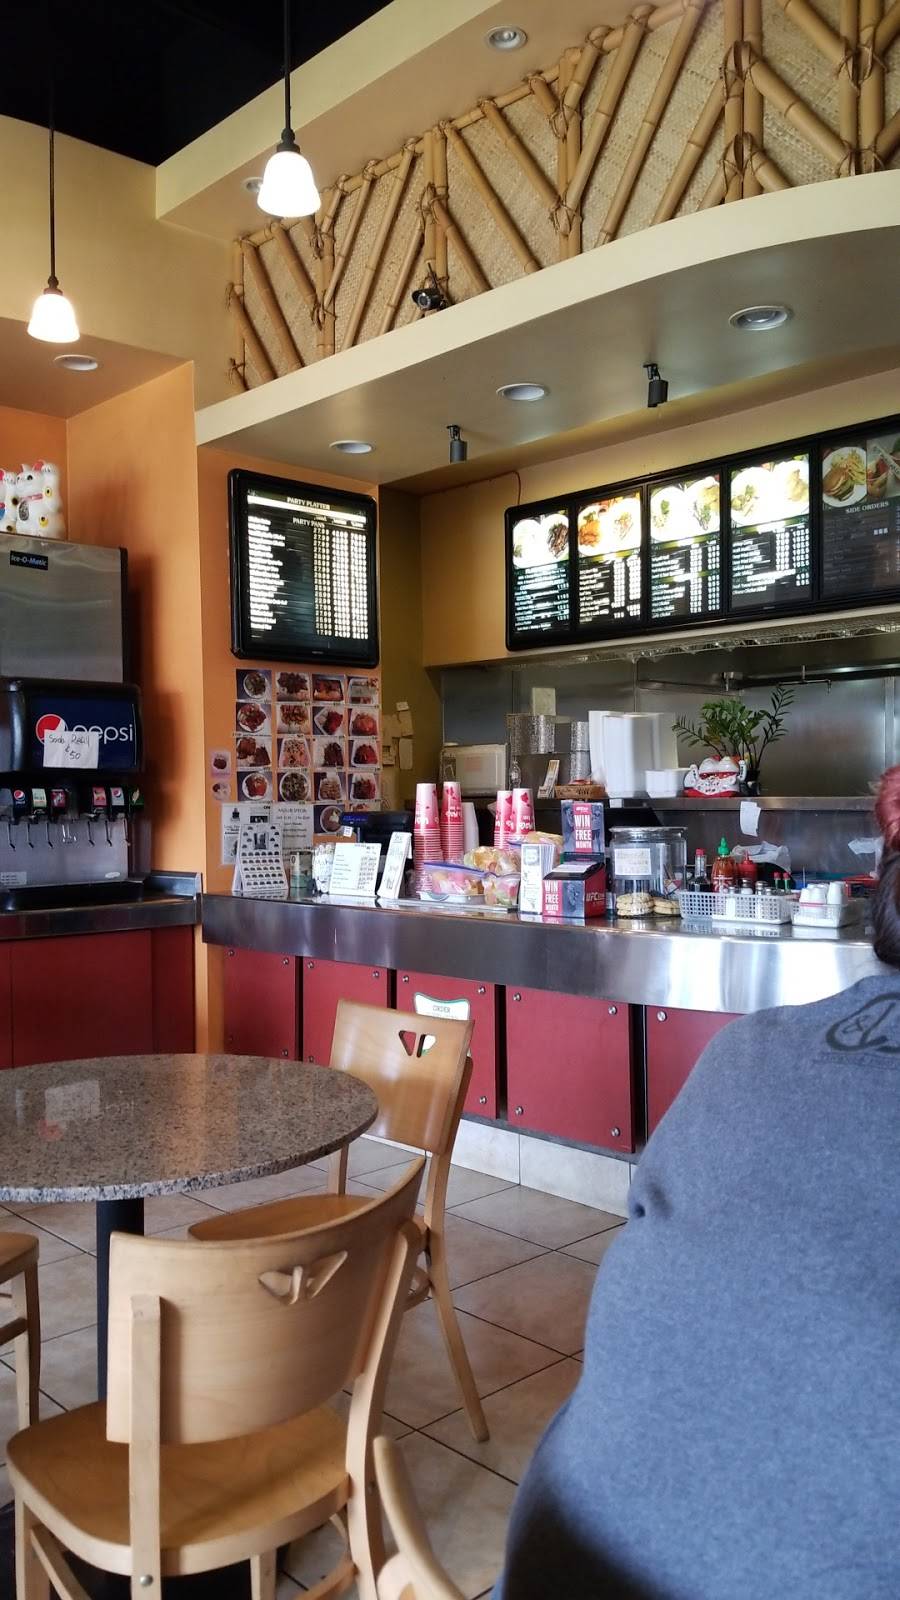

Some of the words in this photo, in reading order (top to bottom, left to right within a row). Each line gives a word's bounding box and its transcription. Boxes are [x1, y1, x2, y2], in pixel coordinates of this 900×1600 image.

[287, 497, 306, 506] PARTY
[306, 500, 330, 510] PLATTER
[845, 504, 861, 514] SIDE
[862, 501, 889, 511] ORDERS
[293, 517, 310, 525] PARTY
[574, 814, 590, 829] WIN
[575, 829, 592, 841] FREE
[544, 880, 559, 893] WIN
[545, 894, 559, 904] FREE
